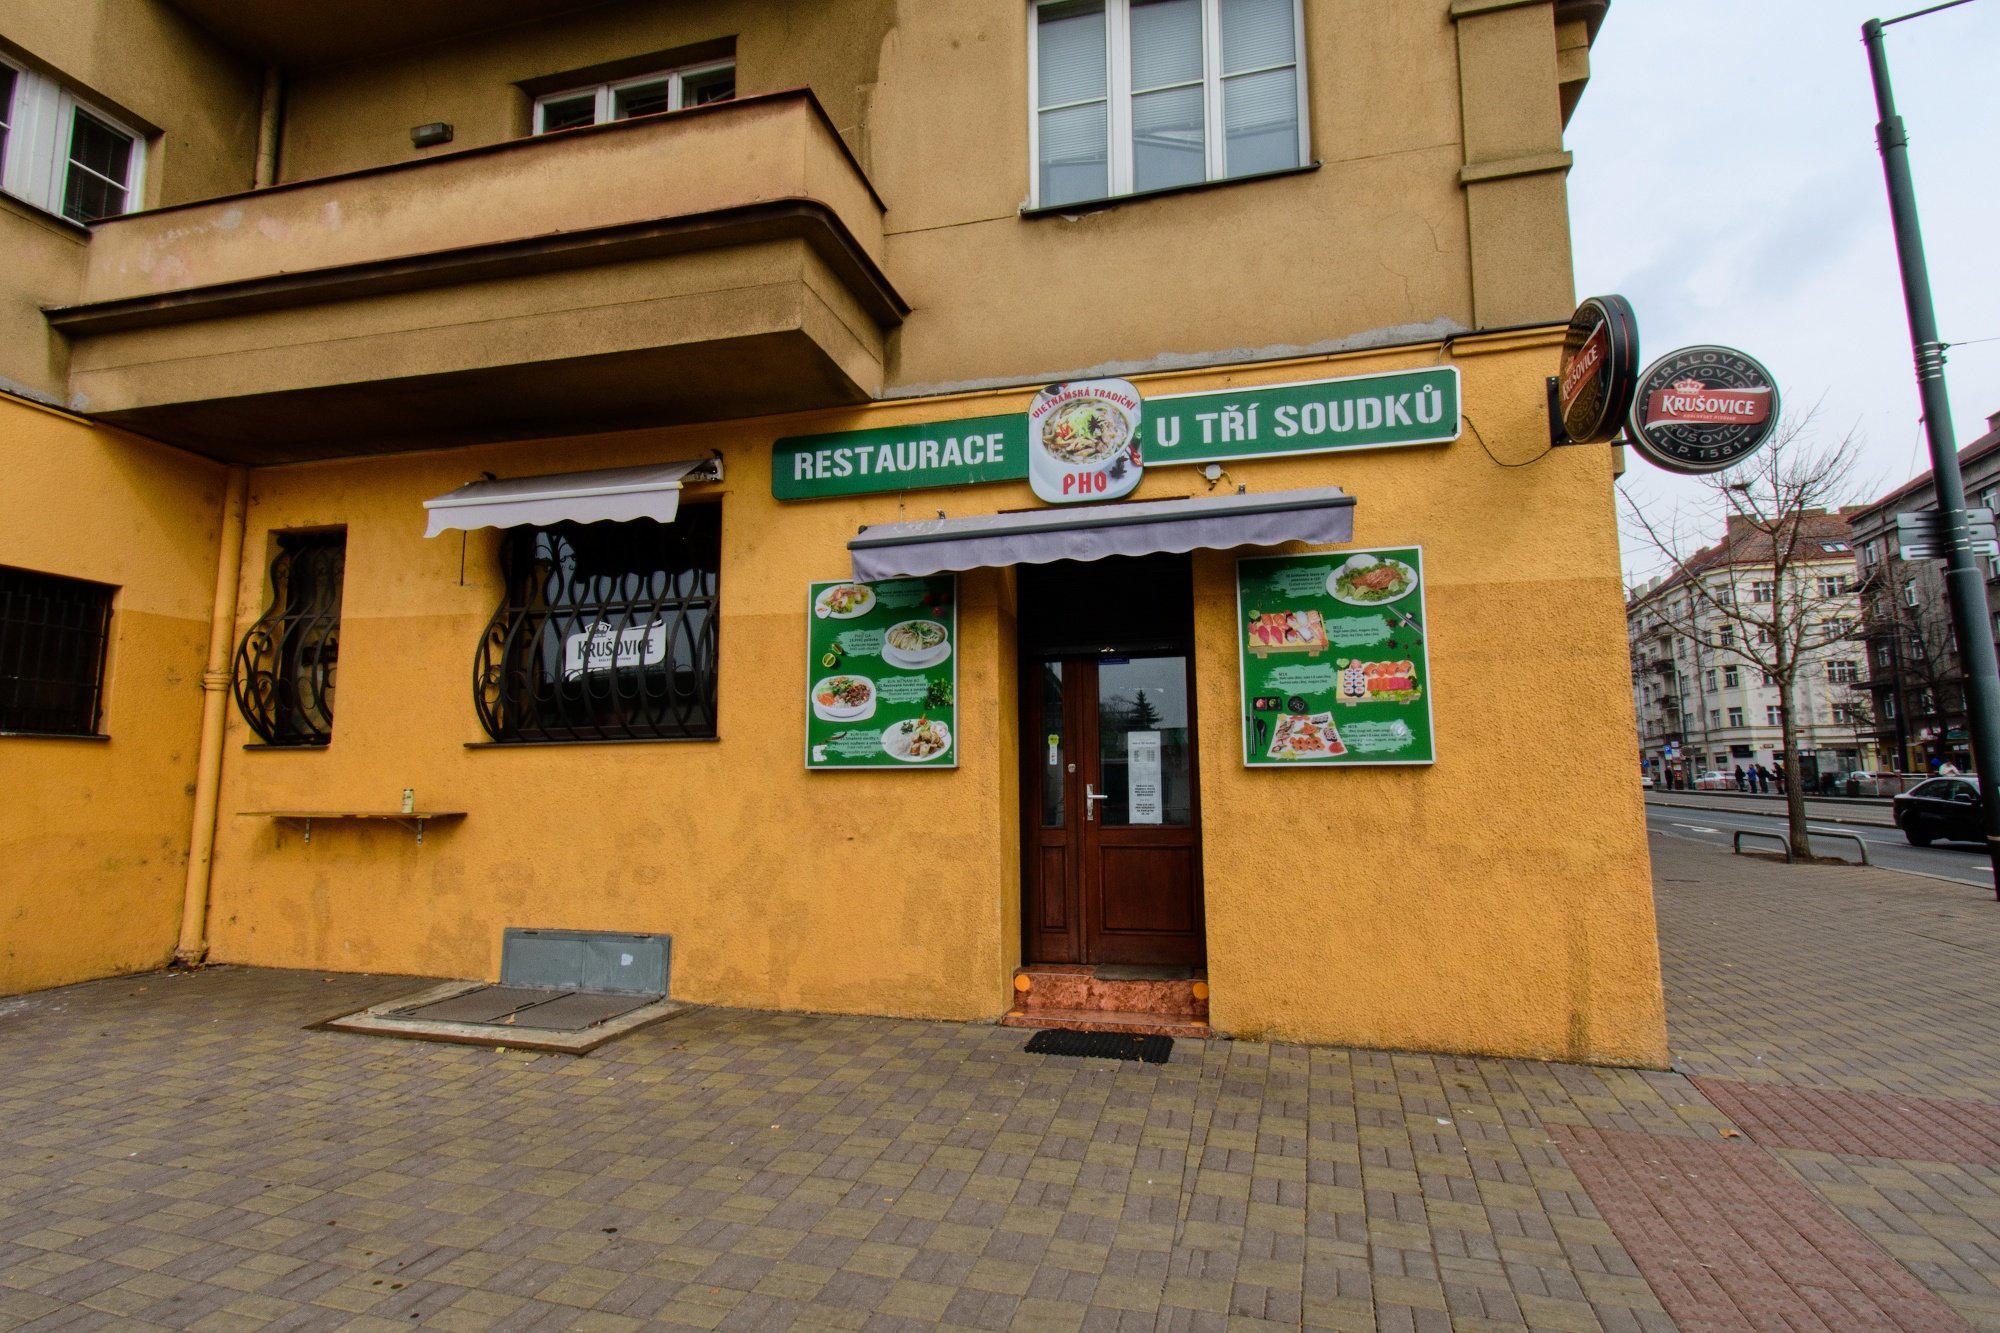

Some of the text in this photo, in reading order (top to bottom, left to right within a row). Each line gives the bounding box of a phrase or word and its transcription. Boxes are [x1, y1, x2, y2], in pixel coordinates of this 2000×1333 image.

[1032, 387, 1138, 419] VIETNAMSKÁ TRADIČNÍ
[1661, 396, 1755, 415] KRUŠOVICE
[1156, 384, 1442, 447] U TŘÍ SOUDKŮ
[1669, 425, 1742, 444] RUŠOVIC
[794, 433, 1004, 481] RESTAURACE
[1698, 441, 1743, 459] 1581
[1062, 471, 1107, 495] PHO
